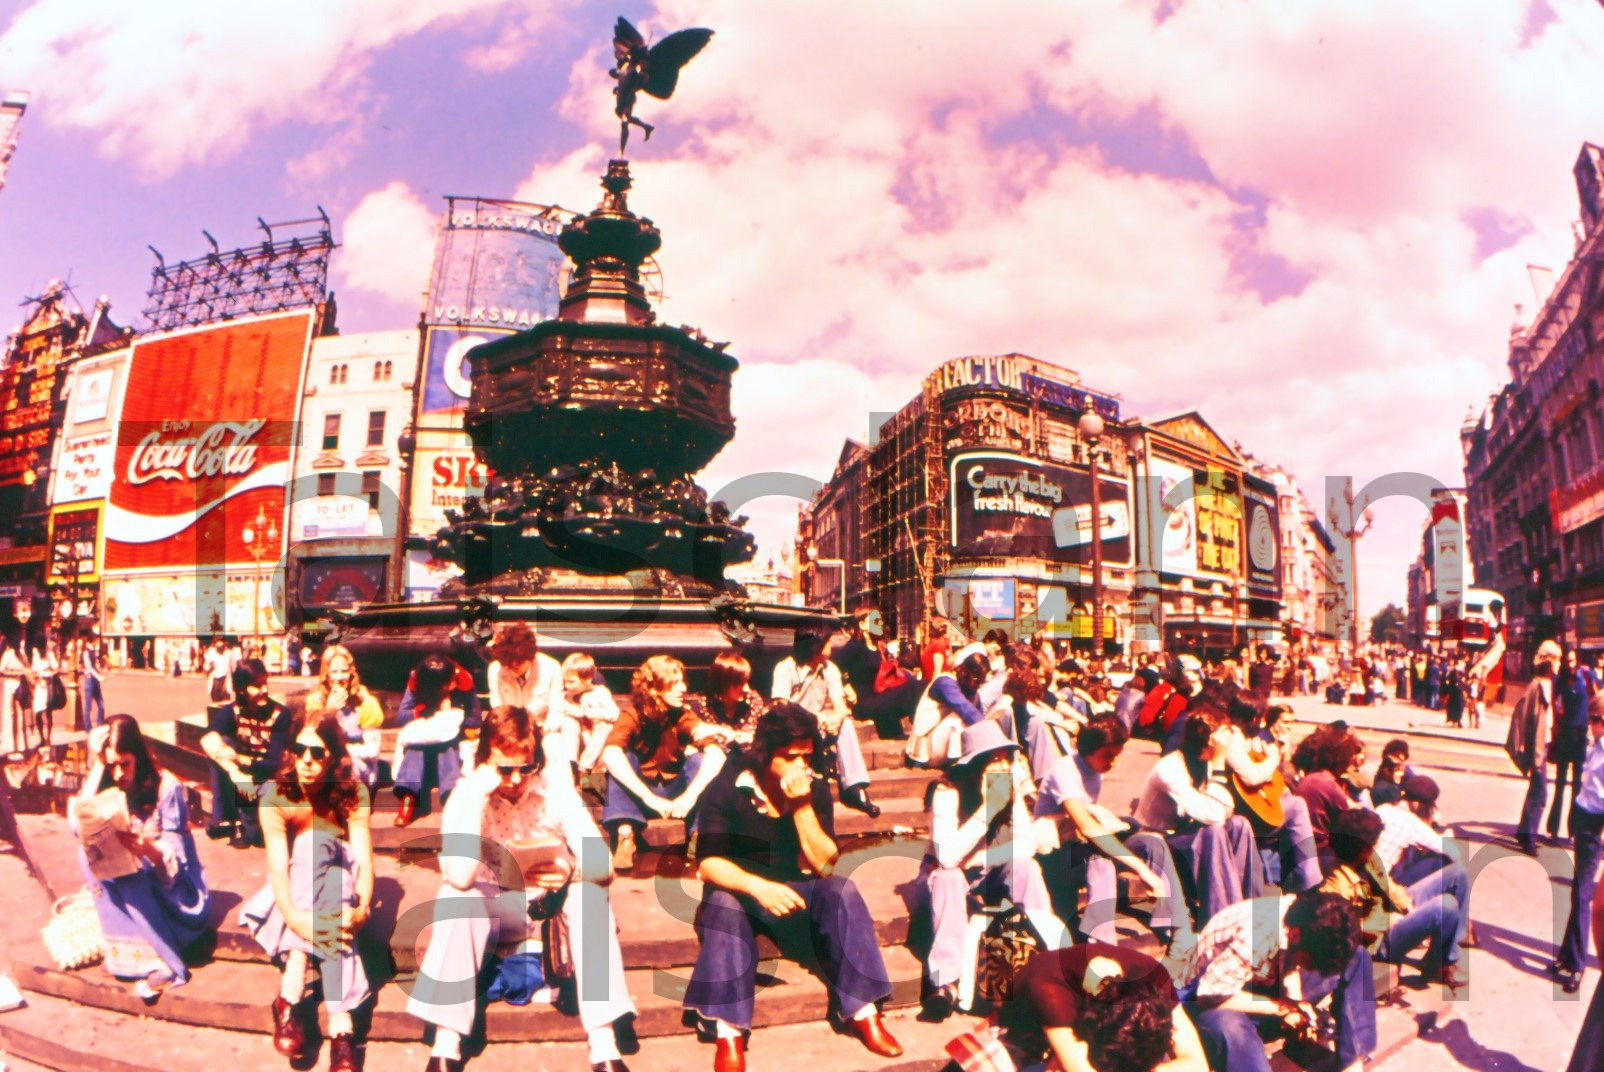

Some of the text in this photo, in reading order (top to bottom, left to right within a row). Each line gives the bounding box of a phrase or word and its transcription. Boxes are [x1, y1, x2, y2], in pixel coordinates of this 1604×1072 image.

[434, 305, 555, 326] VOLKSWAG
[162, 419, 191, 432] Enjoy
[967, 465, 1062, 503] Carry the big
[316, 505, 329, 514] TO
[974, 489, 1013, 511] fresh
